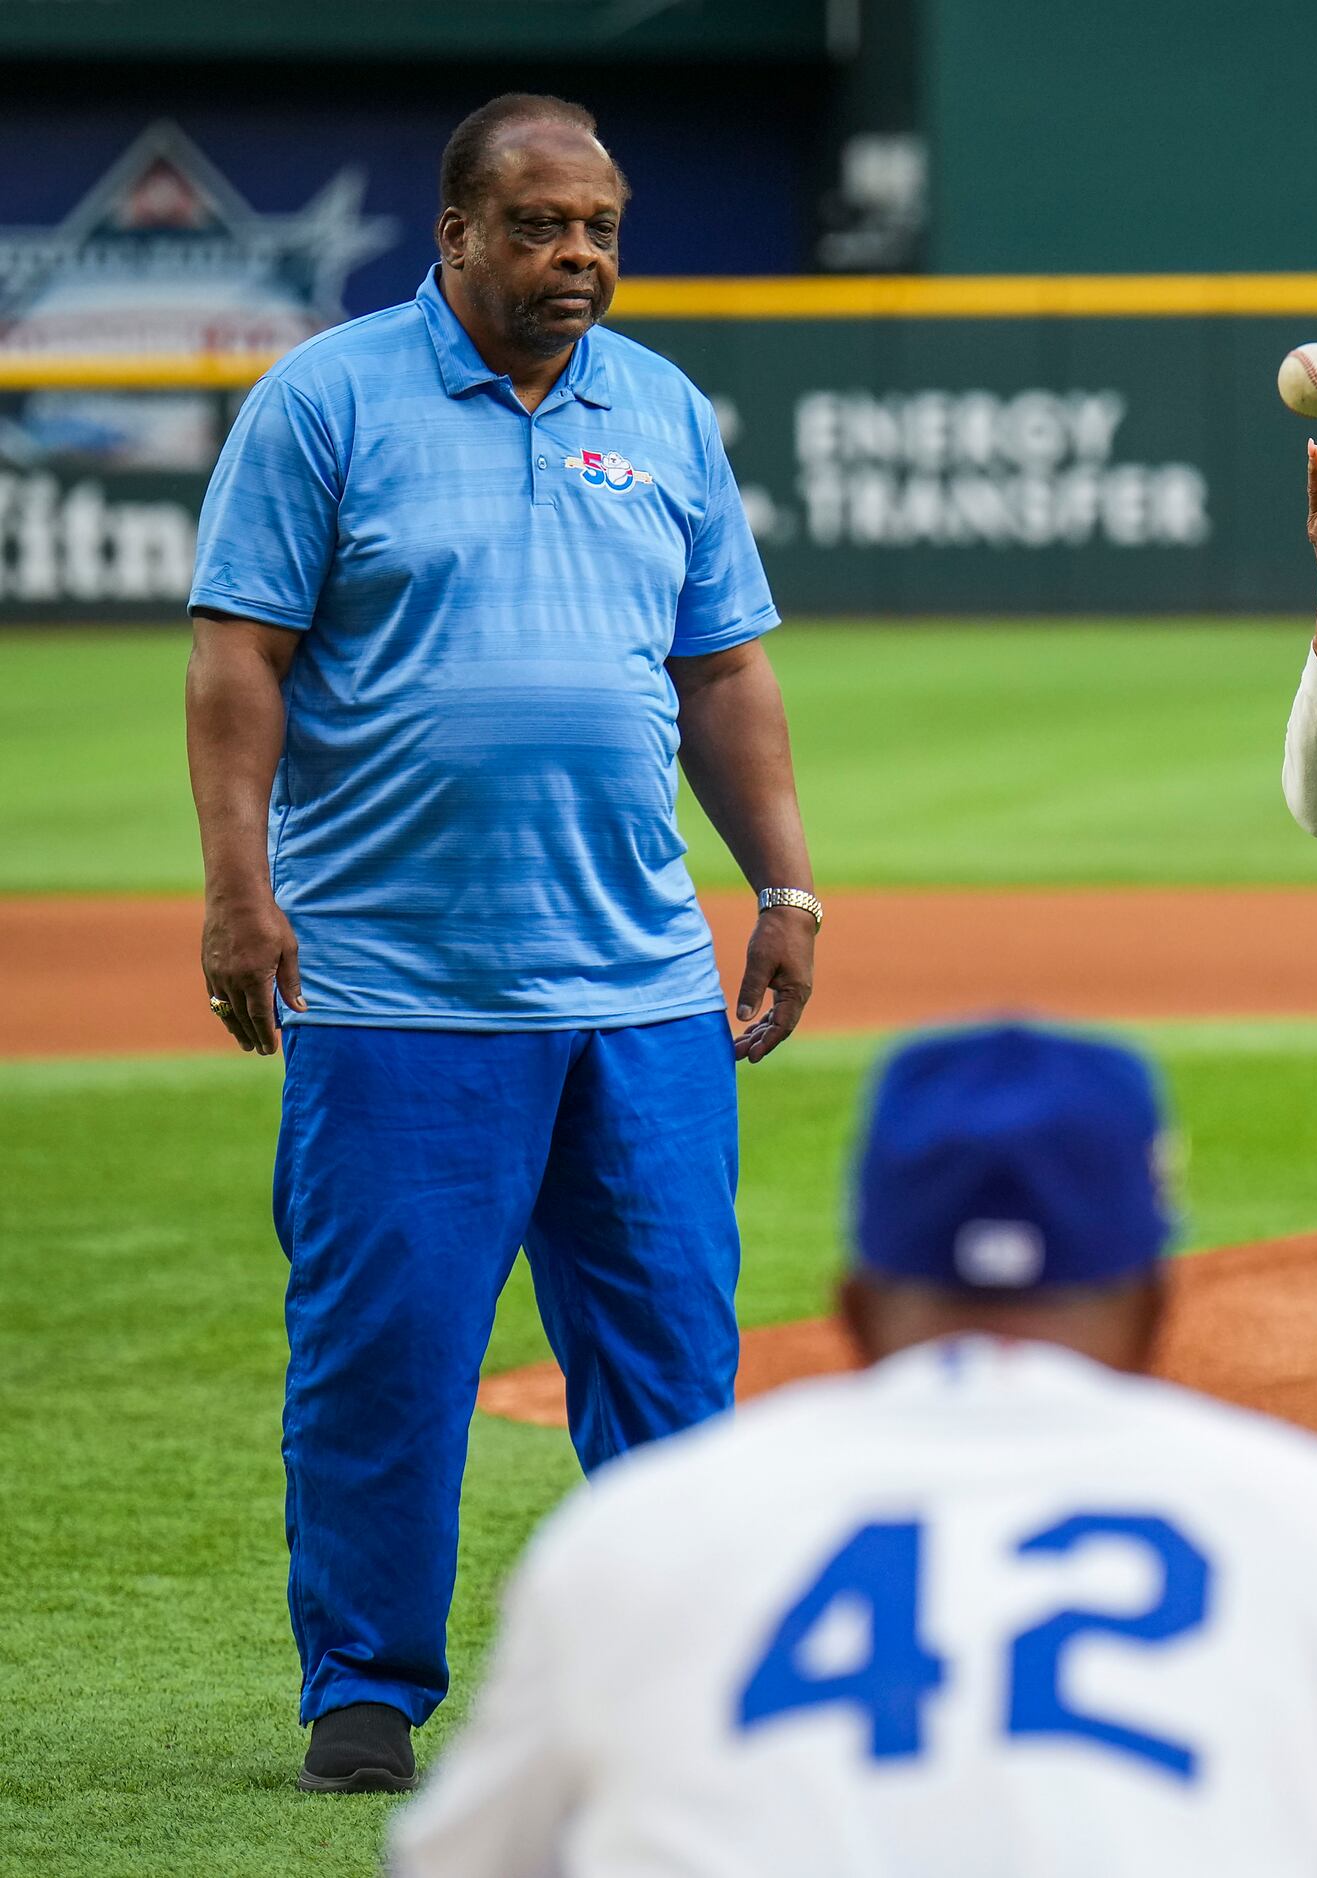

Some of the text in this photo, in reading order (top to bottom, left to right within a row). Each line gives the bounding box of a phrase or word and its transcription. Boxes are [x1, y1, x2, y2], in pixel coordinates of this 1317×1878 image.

[796, 391, 1124, 464] ENERGY
[802, 463, 1211, 545] TRANSFER
[737, 1512, 1216, 1782] 42
